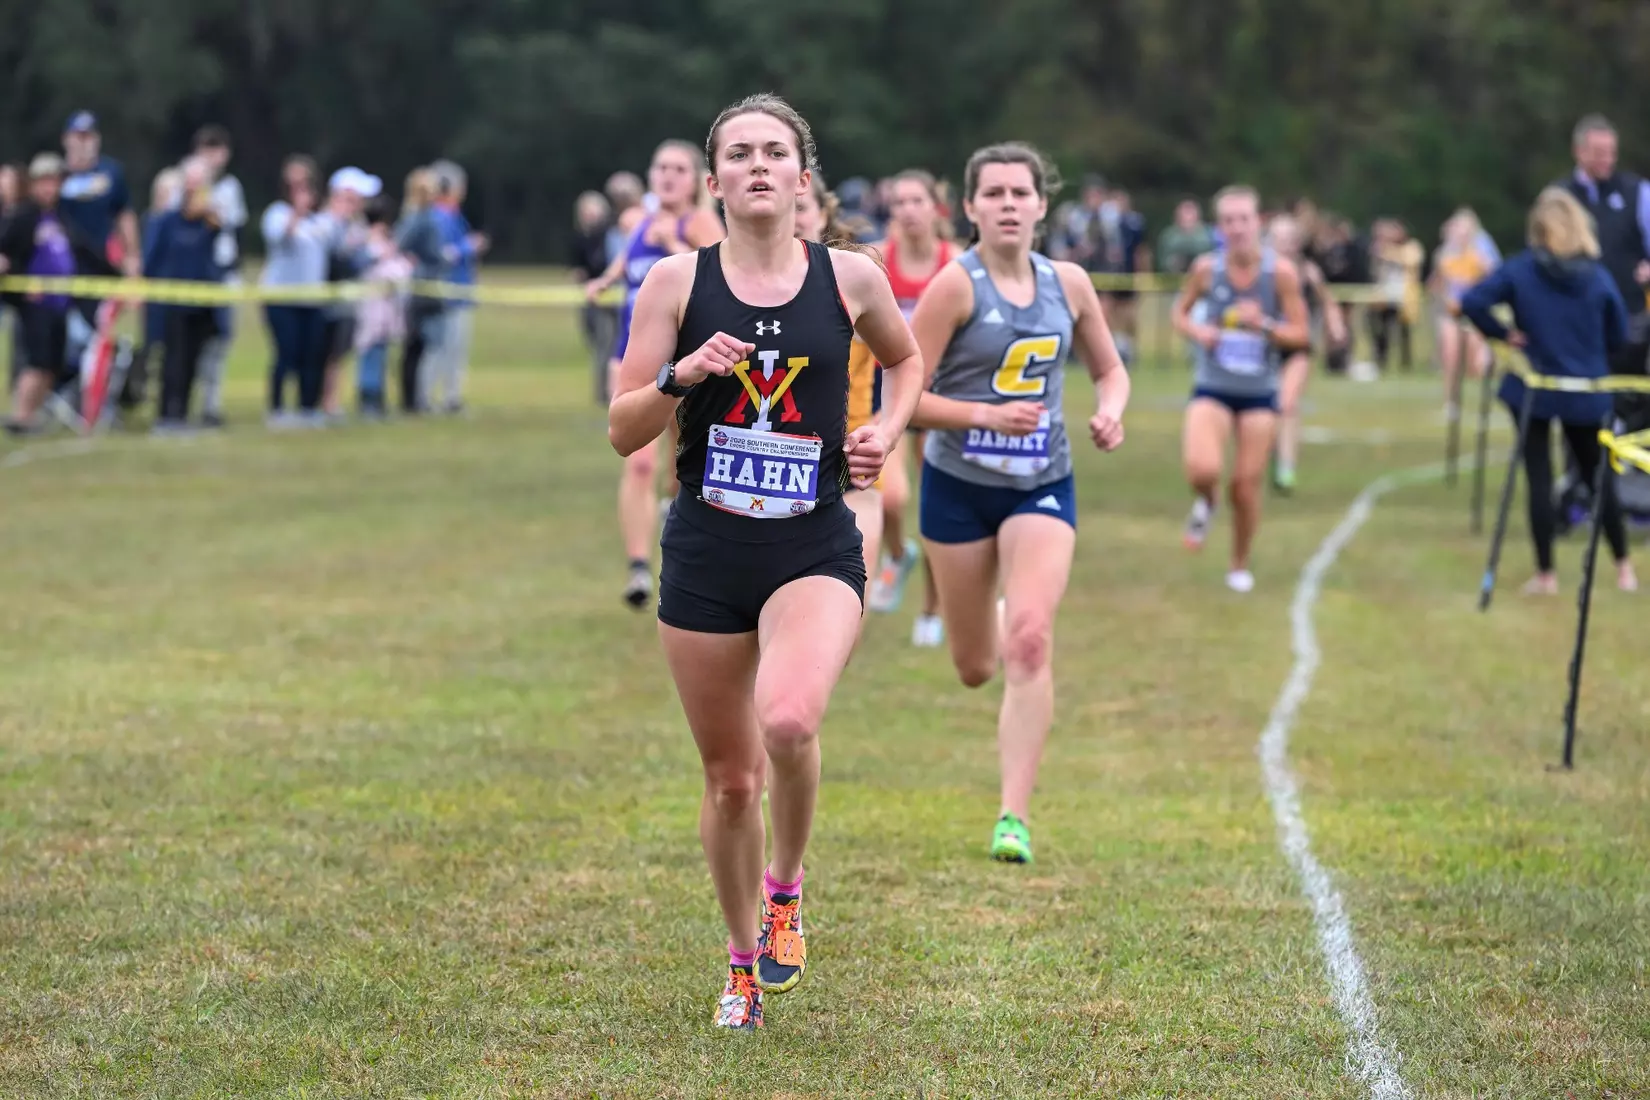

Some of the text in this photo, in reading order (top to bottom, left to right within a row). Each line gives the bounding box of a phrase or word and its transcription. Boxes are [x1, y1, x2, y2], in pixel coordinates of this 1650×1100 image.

[991, 333, 1061, 397] C
[729, 437, 746, 445] 2022
[747, 439, 779, 449] SOUTHERN
[780, 443, 818, 453] CONFERENCE
[967, 428, 1047, 451] DABNEY
[770, 449, 809, 457] CHAMPIONSHIPS
[709, 452, 814, 493] HAHN
